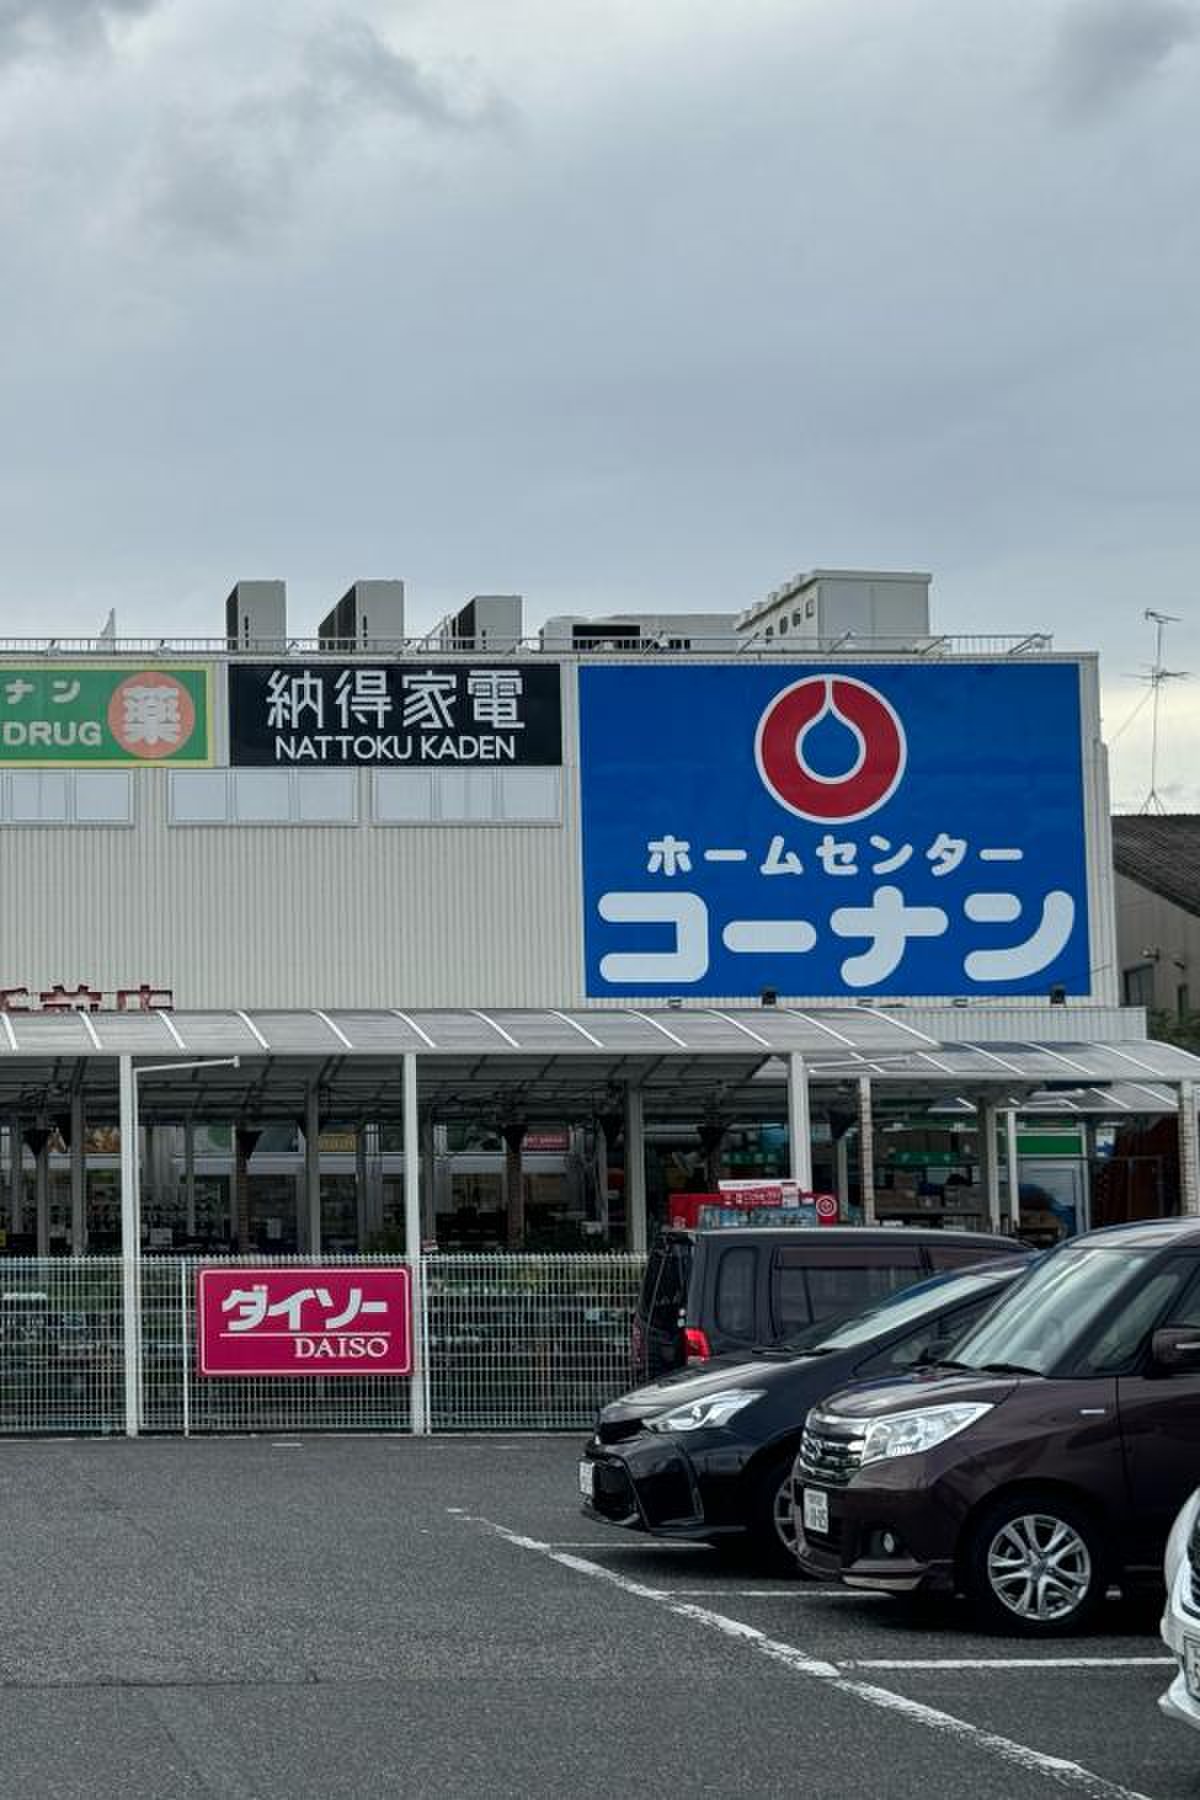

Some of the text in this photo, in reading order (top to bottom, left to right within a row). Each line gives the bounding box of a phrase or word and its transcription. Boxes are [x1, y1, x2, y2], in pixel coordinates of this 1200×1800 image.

[126, 686, 180, 744] 薬
[266, 669, 526, 729] 納得家電
[2, 721, 101, 747] DRUG
[275, 735, 516, 760] NATTOKU KADEN
[647, 833, 1023, 876] ホームセンター
[598, 885, 1076, 987] コーナン
[221, 1284, 388, 1331] ダイソー
[293, 1337, 389, 1359] DAISO
